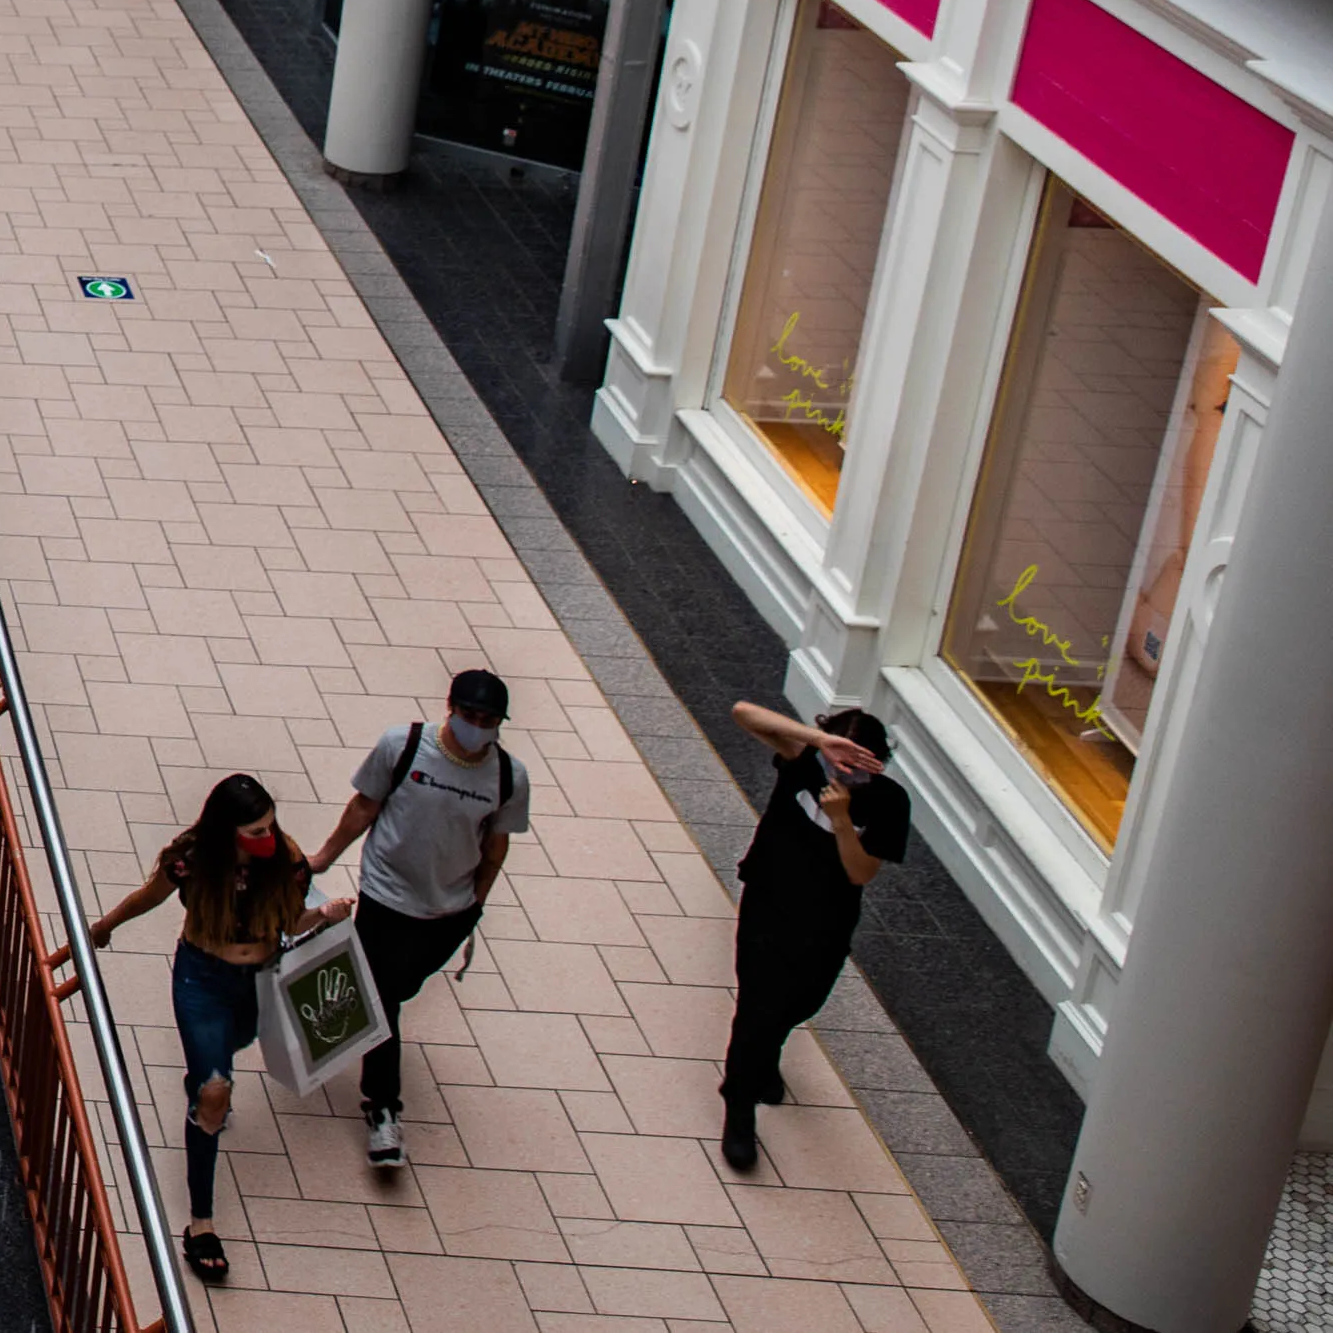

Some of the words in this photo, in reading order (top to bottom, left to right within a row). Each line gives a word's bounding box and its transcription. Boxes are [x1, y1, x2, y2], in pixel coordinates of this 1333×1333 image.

[483, 66, 543, 87] THEATERS
[771, 312, 829, 389] love
[997, 564, 1080, 665] love
[1013, 658, 1117, 742] pink
[411, 769, 493, 804] Champion
